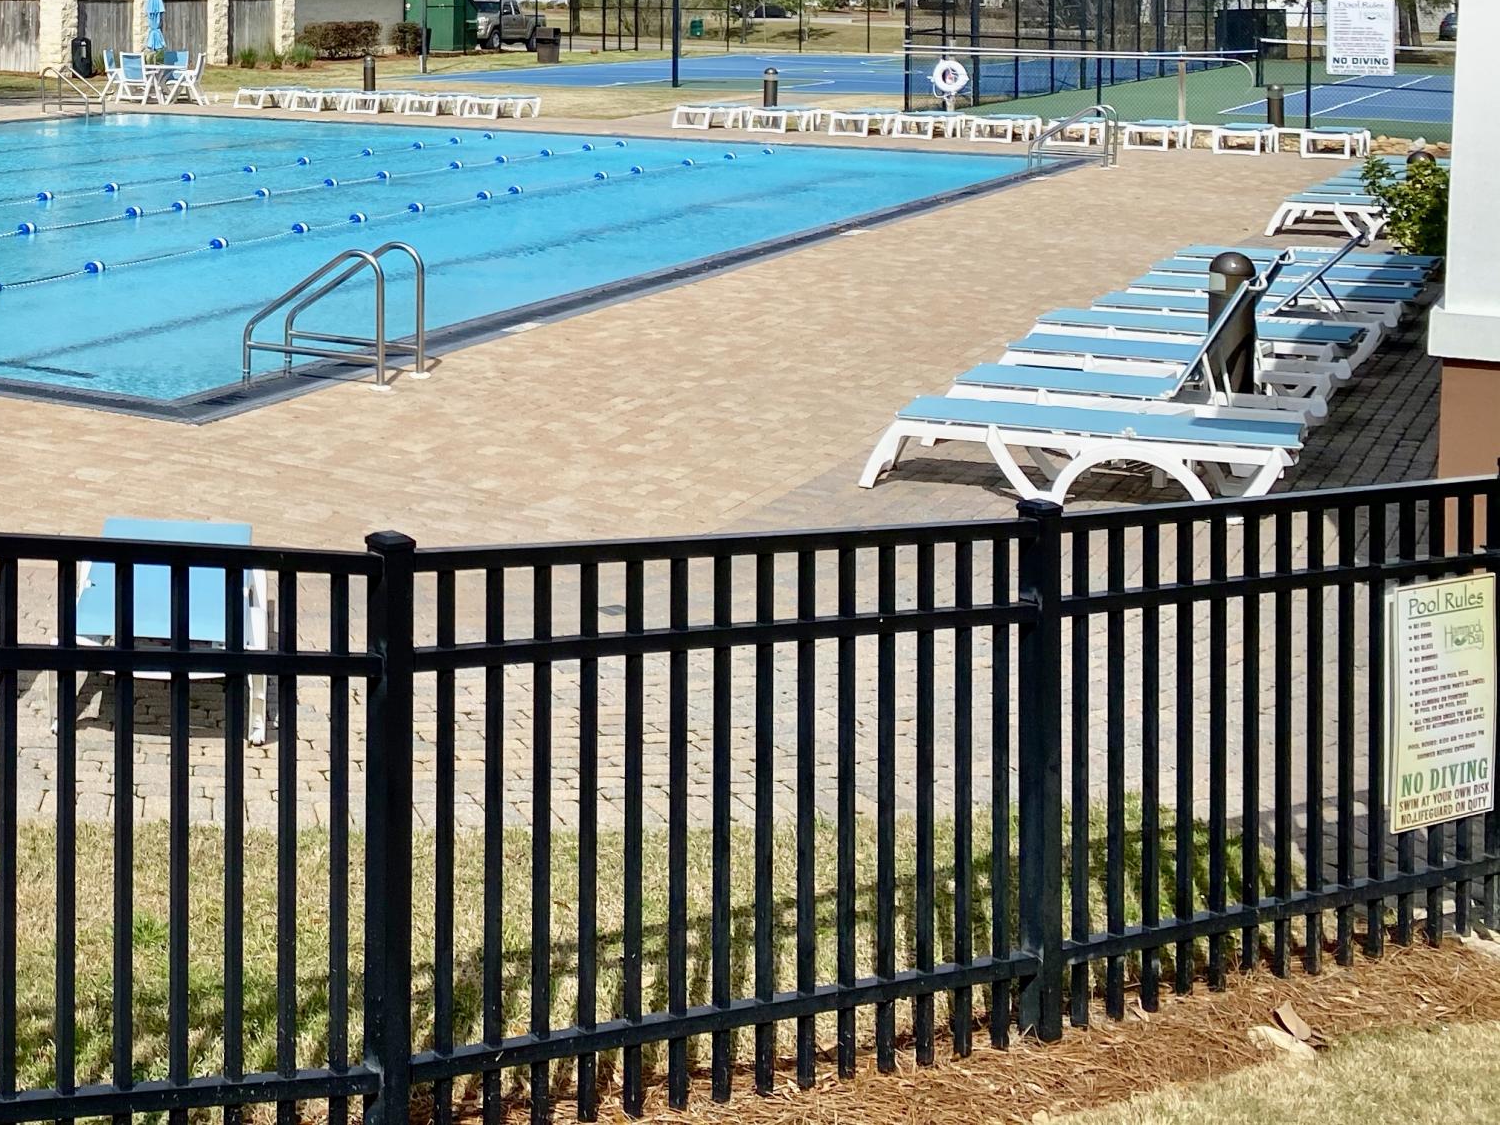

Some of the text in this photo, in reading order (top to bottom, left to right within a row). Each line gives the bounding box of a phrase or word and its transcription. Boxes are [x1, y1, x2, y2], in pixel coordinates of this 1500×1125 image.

[1352, 57, 1388, 65] DIVING
[1408, 584, 1484, 615] Pool Rules
[1401, 758, 1488, 798] NO DIVING
[1399, 782, 1489, 812] SWIM AT YOUR OWN RISK
[1401, 813, 1411, 825] NO
[1456, 801, 1465, 813] ON
[1468, 796, 1487, 812] DUTY
